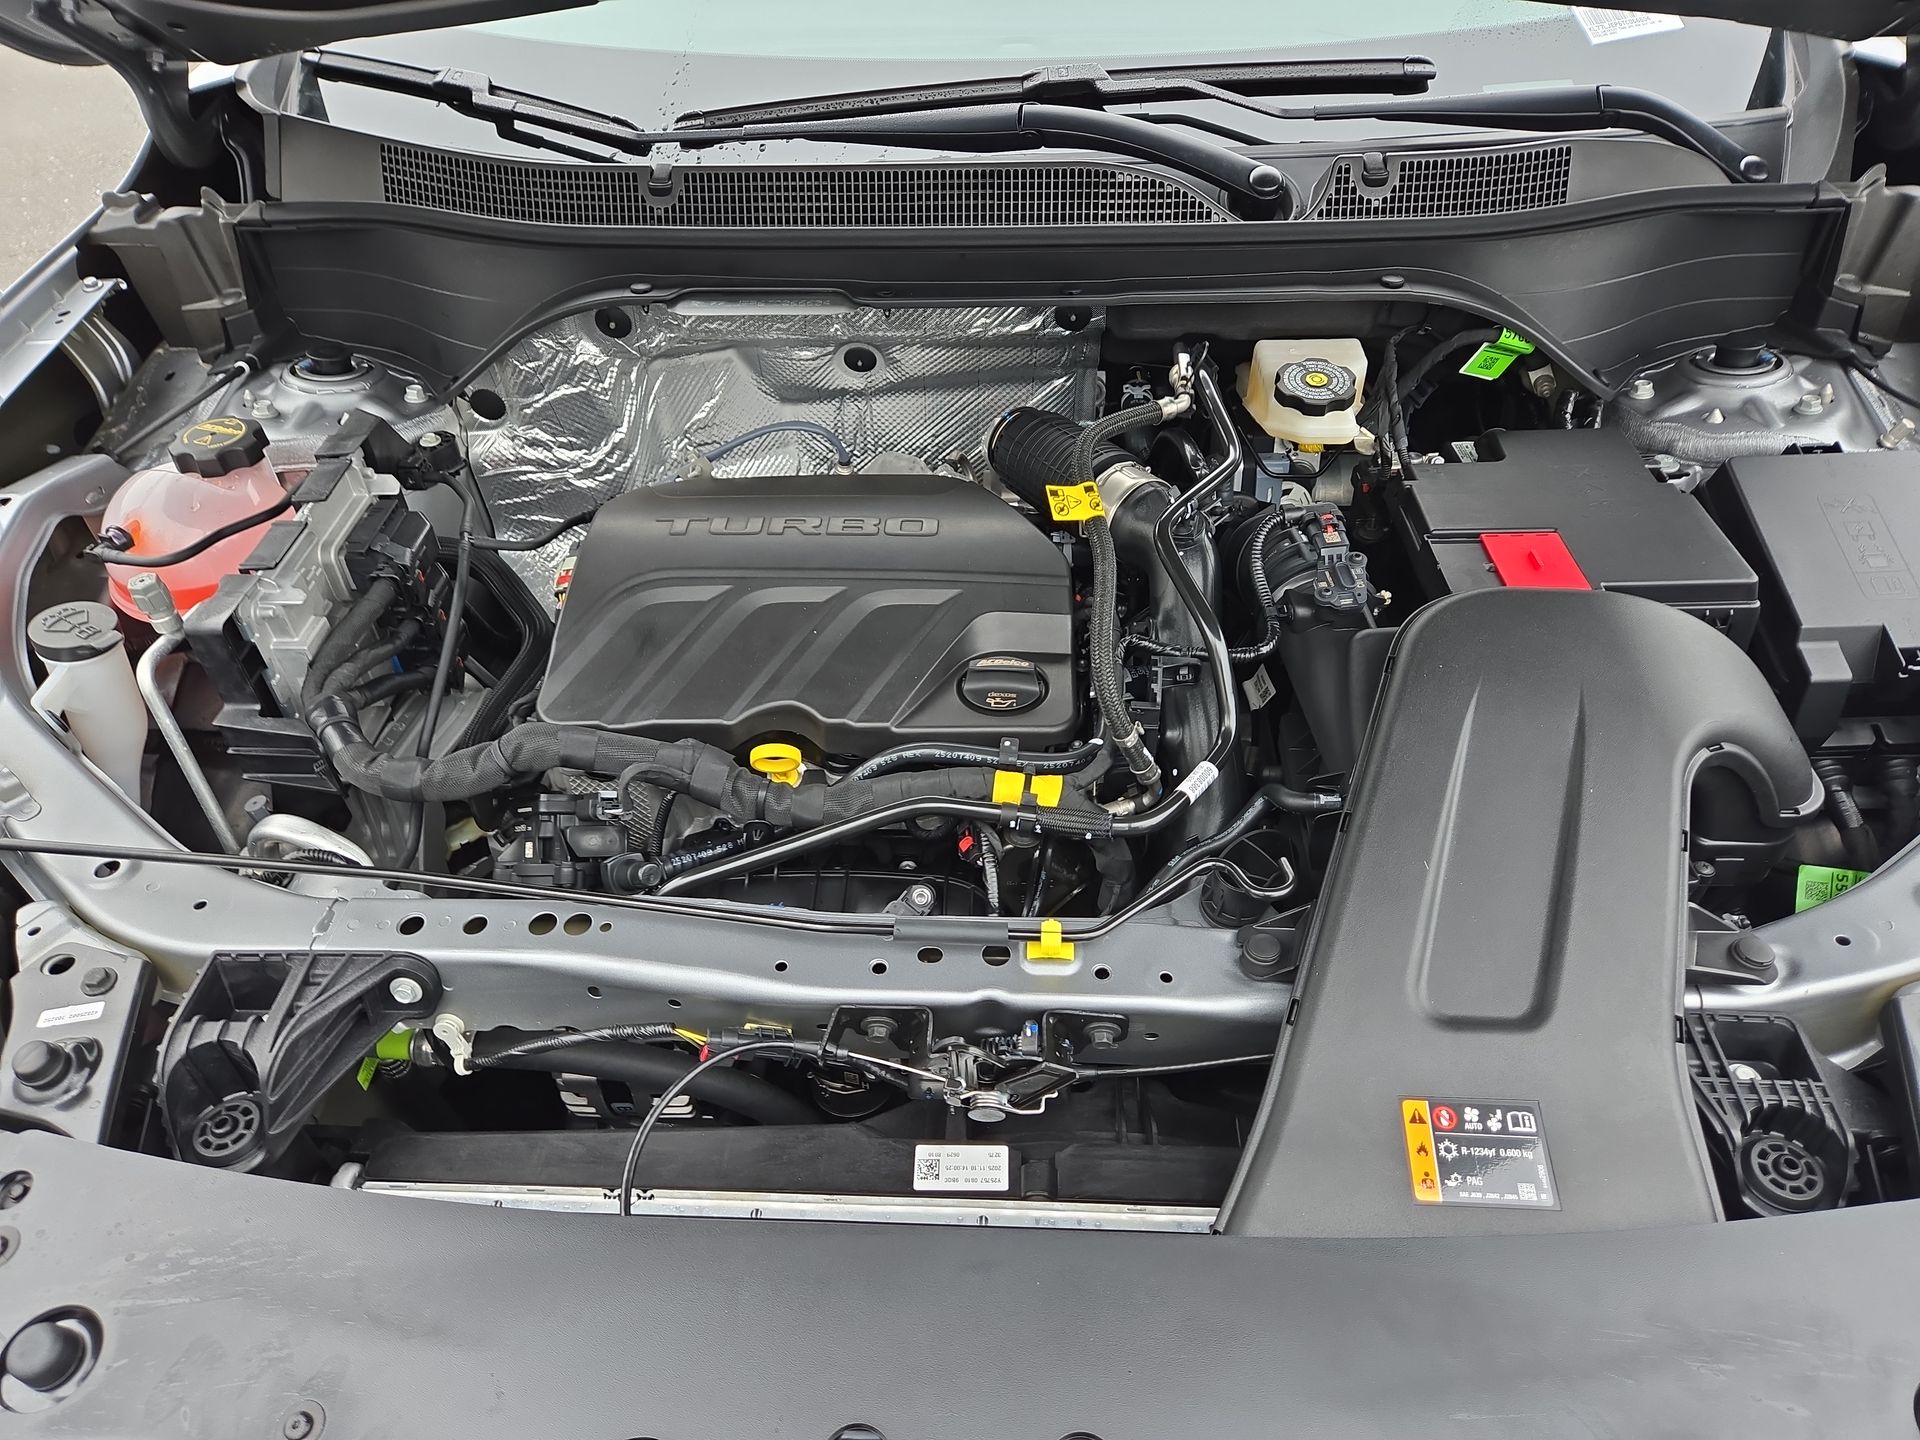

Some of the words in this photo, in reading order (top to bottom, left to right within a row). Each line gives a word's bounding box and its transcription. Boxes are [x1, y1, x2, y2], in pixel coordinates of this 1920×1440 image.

[655, 516, 940, 537] TURBO
[975, 658, 1030, 667] ACDelco
[902, 750, 921, 759] HEX
[934, 750, 982, 762] 25207409
[986, 756, 1000, 765] 52
[671, 848, 713, 866] 25207409
[1464, 1122, 1483, 1130] AUTO
[1461, 1146, 1496, 1158] R-1234yf
[1499, 1149, 1522, 1157] 0.600
[1522, 1150, 1533, 1160] kg
[1466, 1175, 1484, 1186] PAG
